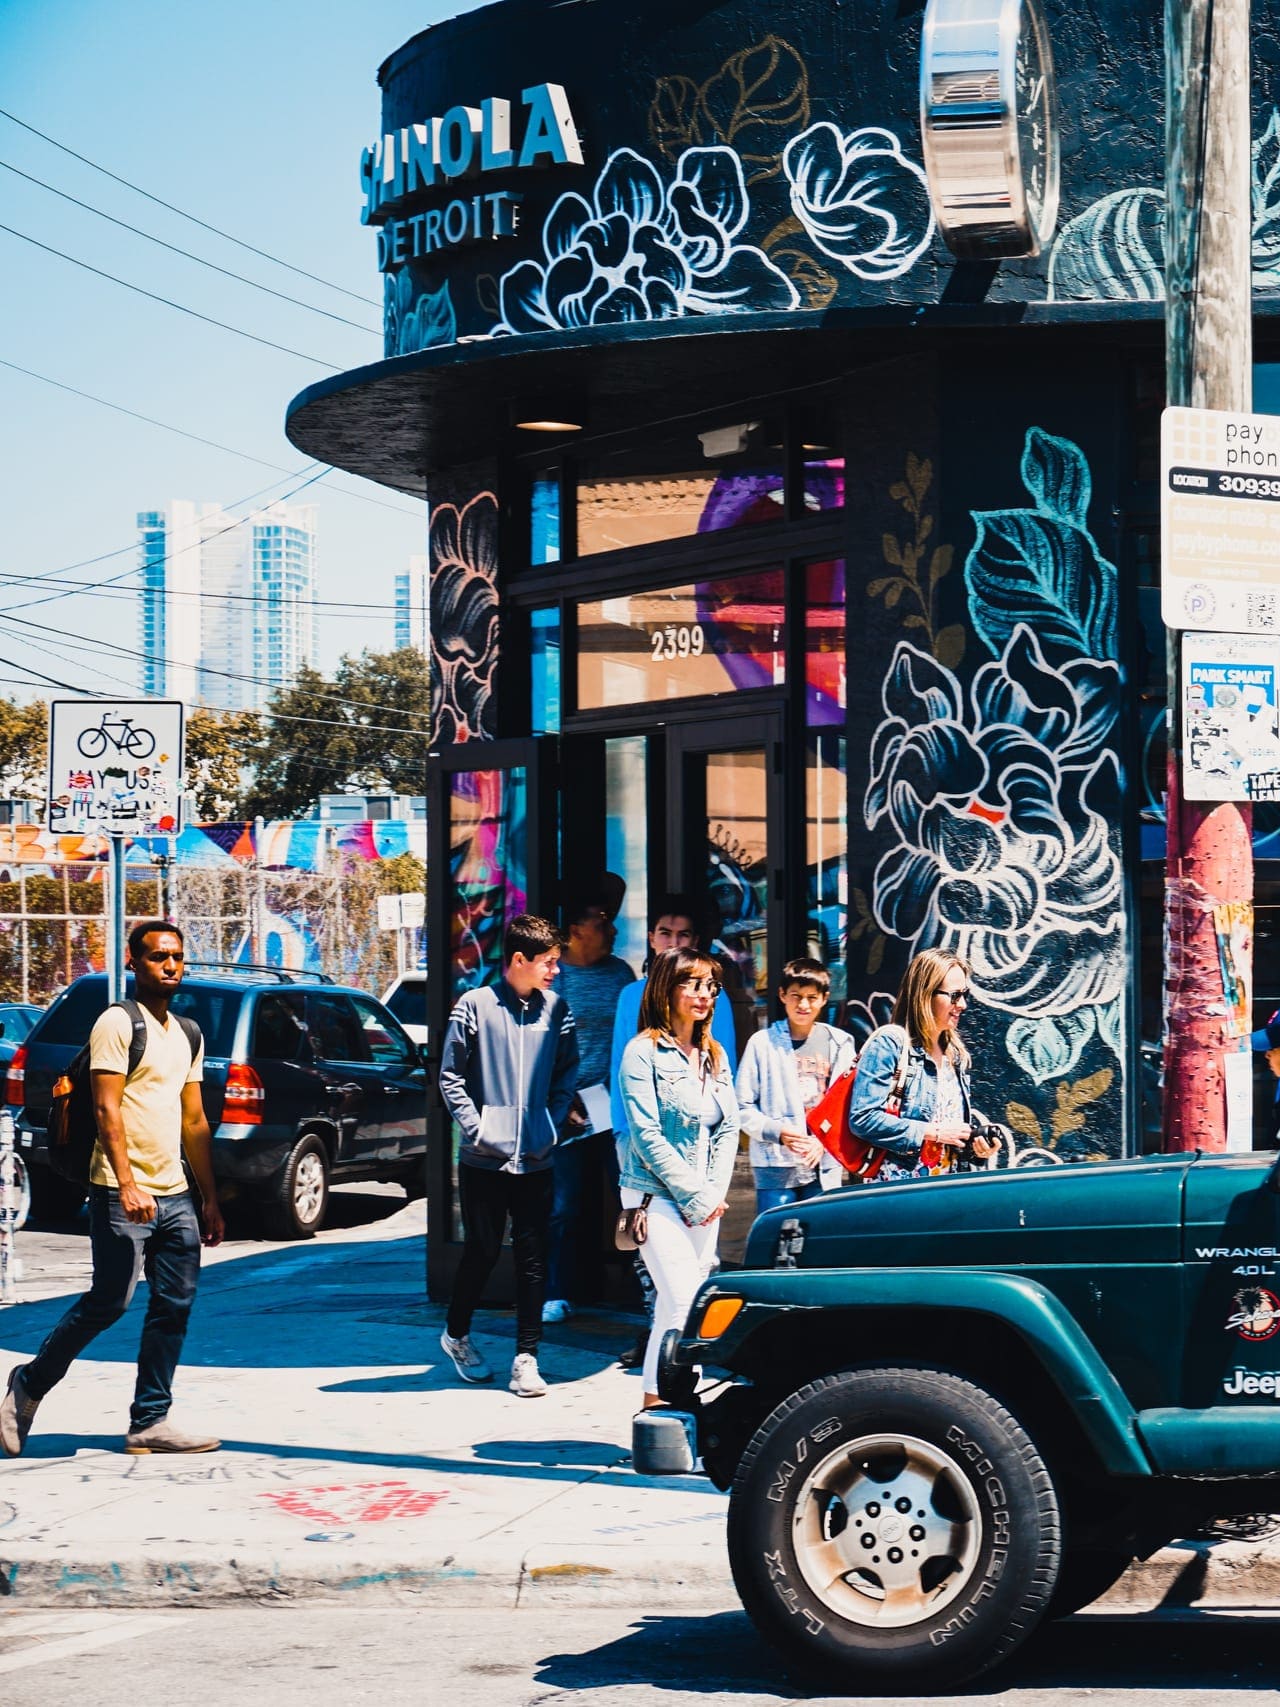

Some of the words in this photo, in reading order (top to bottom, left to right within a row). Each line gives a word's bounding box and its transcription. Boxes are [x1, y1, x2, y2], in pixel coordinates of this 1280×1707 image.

[360, 82, 584, 226] SHINOLA
[376, 191, 522, 272] DETROIT
[1226, 423, 1263, 445] pay
[651, 625, 704, 662] 2399
[1192, 668, 1226, 683] PARK
[1226, 669, 1272, 685] SMART
[928, 1424, 1011, 1647] MICHELIN
[764, 1549, 825, 1636] LTX
